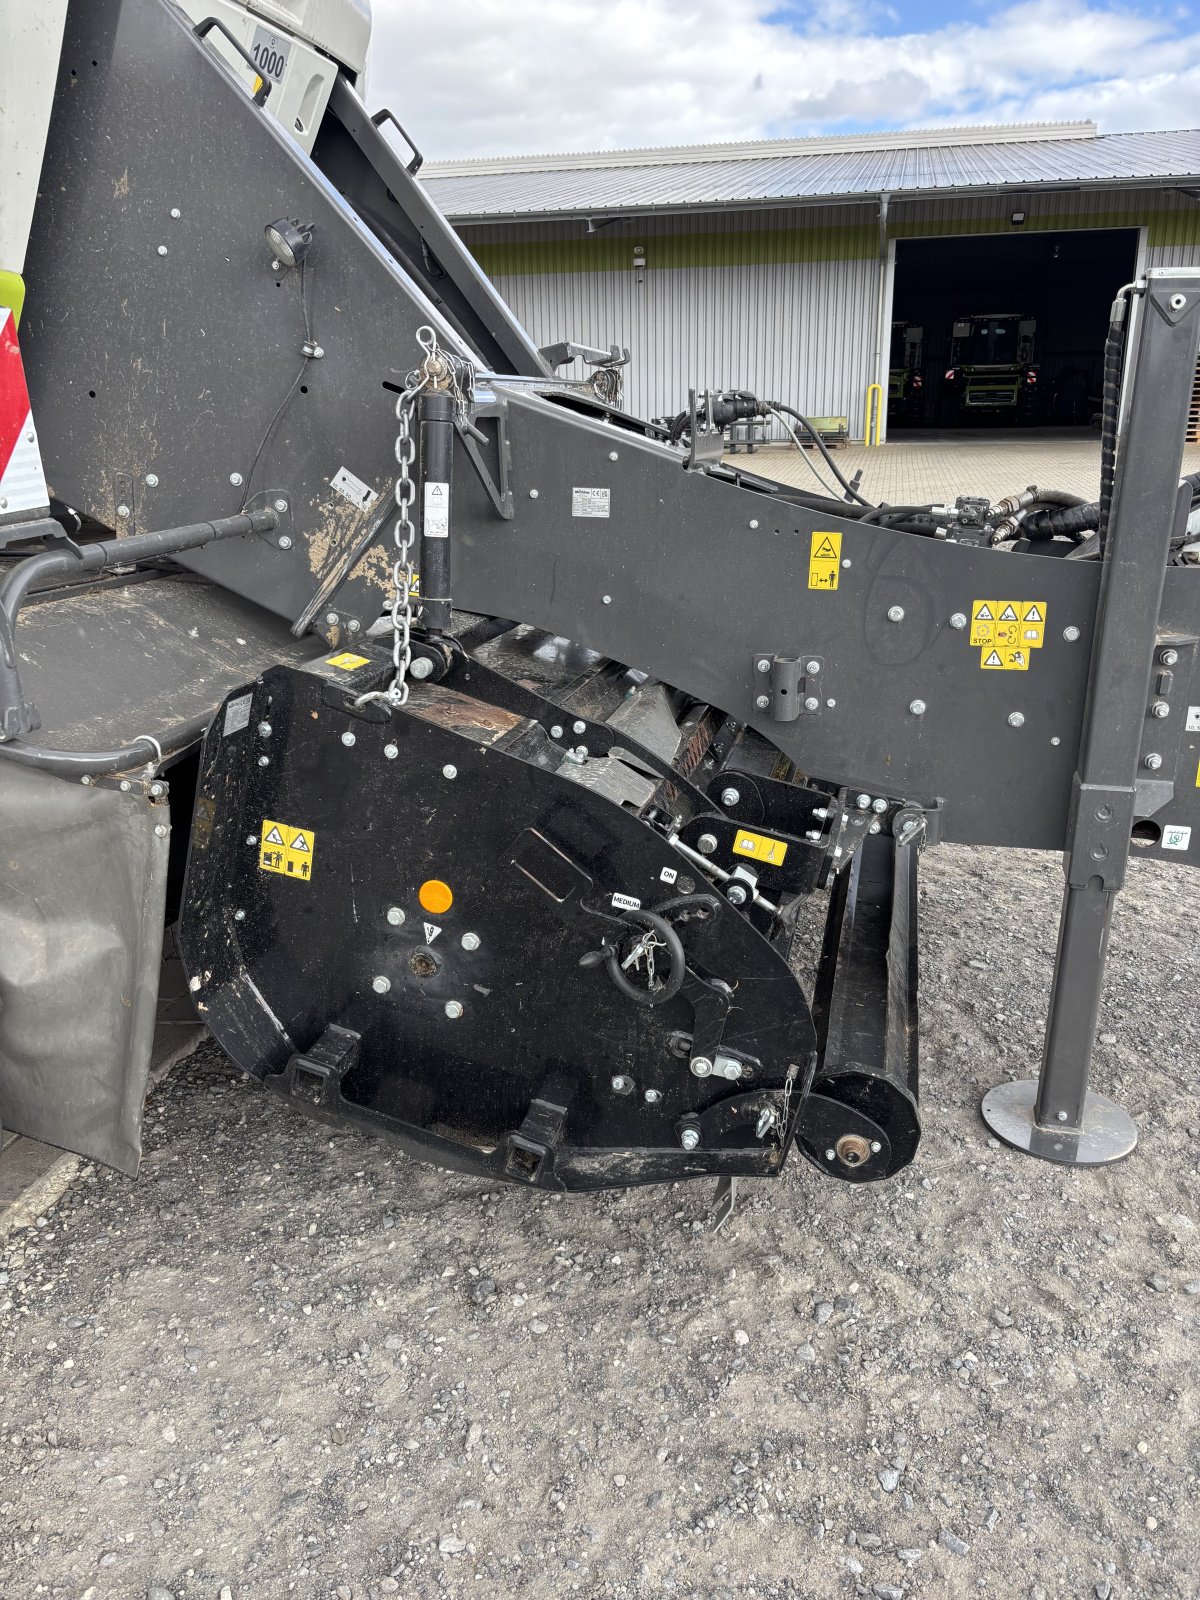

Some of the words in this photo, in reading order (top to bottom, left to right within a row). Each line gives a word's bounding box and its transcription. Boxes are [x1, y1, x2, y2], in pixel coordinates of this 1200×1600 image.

[254, 43, 284, 78] 1000
[663, 870, 675, 879] ON
[613, 896, 640, 908] MEDIUM
